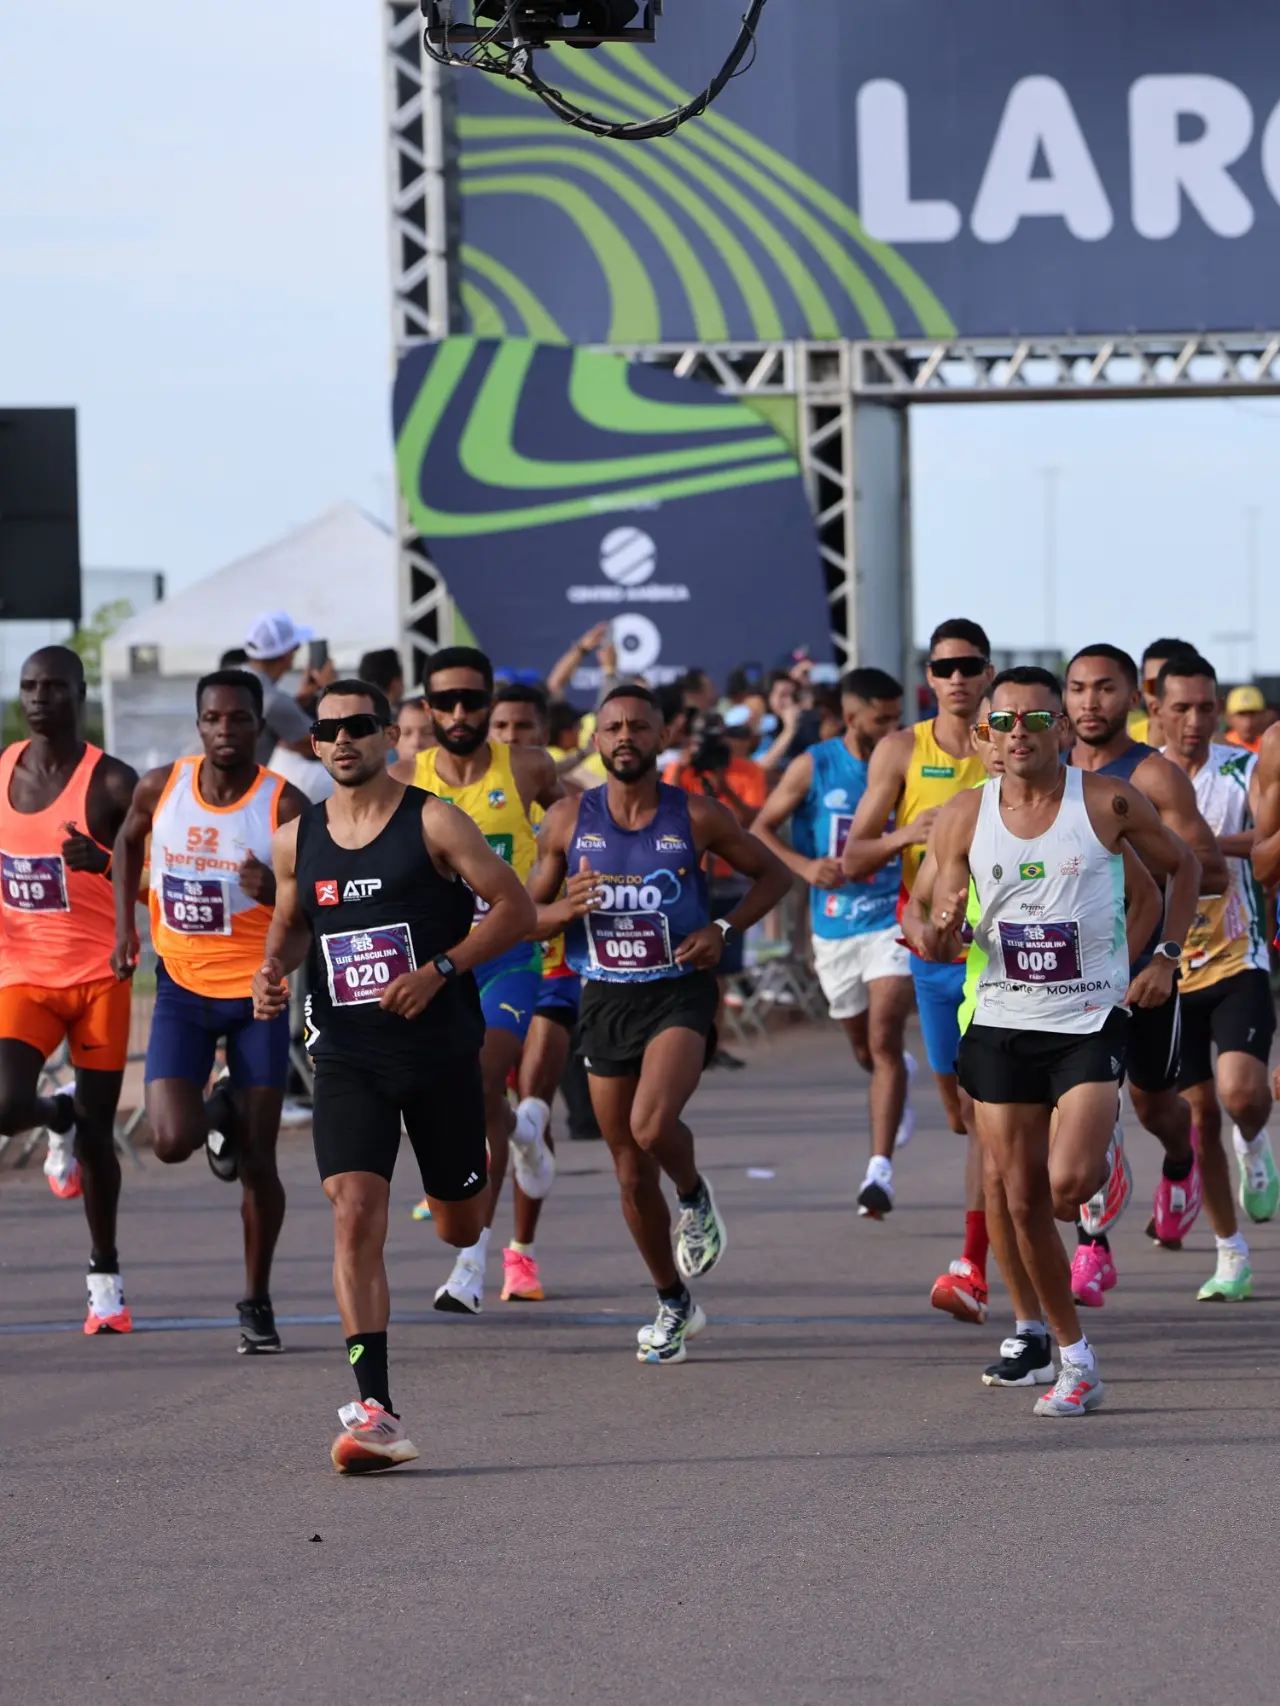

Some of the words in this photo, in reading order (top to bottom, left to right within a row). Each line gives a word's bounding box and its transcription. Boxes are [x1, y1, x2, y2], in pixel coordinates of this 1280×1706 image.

[186, 827, 220, 847] 52
[163, 845, 242, 872] bergam
[343, 878, 382, 897] ATP
[600, 874, 625, 885] PING
[626, 875, 643, 885] DO
[9, 880, 45, 900] 019
[594, 884, 663, 910] ono
[173, 902, 213, 922] 033
[605, 939, 648, 959] 006
[1025, 940, 1068, 949] MASCULINA
[335, 956, 354, 965] ELITE
[353, 948, 398, 963] MASCULINA
[1017, 951, 1058, 972] 008
[345, 961, 390, 988] 020
[1047, 980, 1112, 996] MOMBORA
